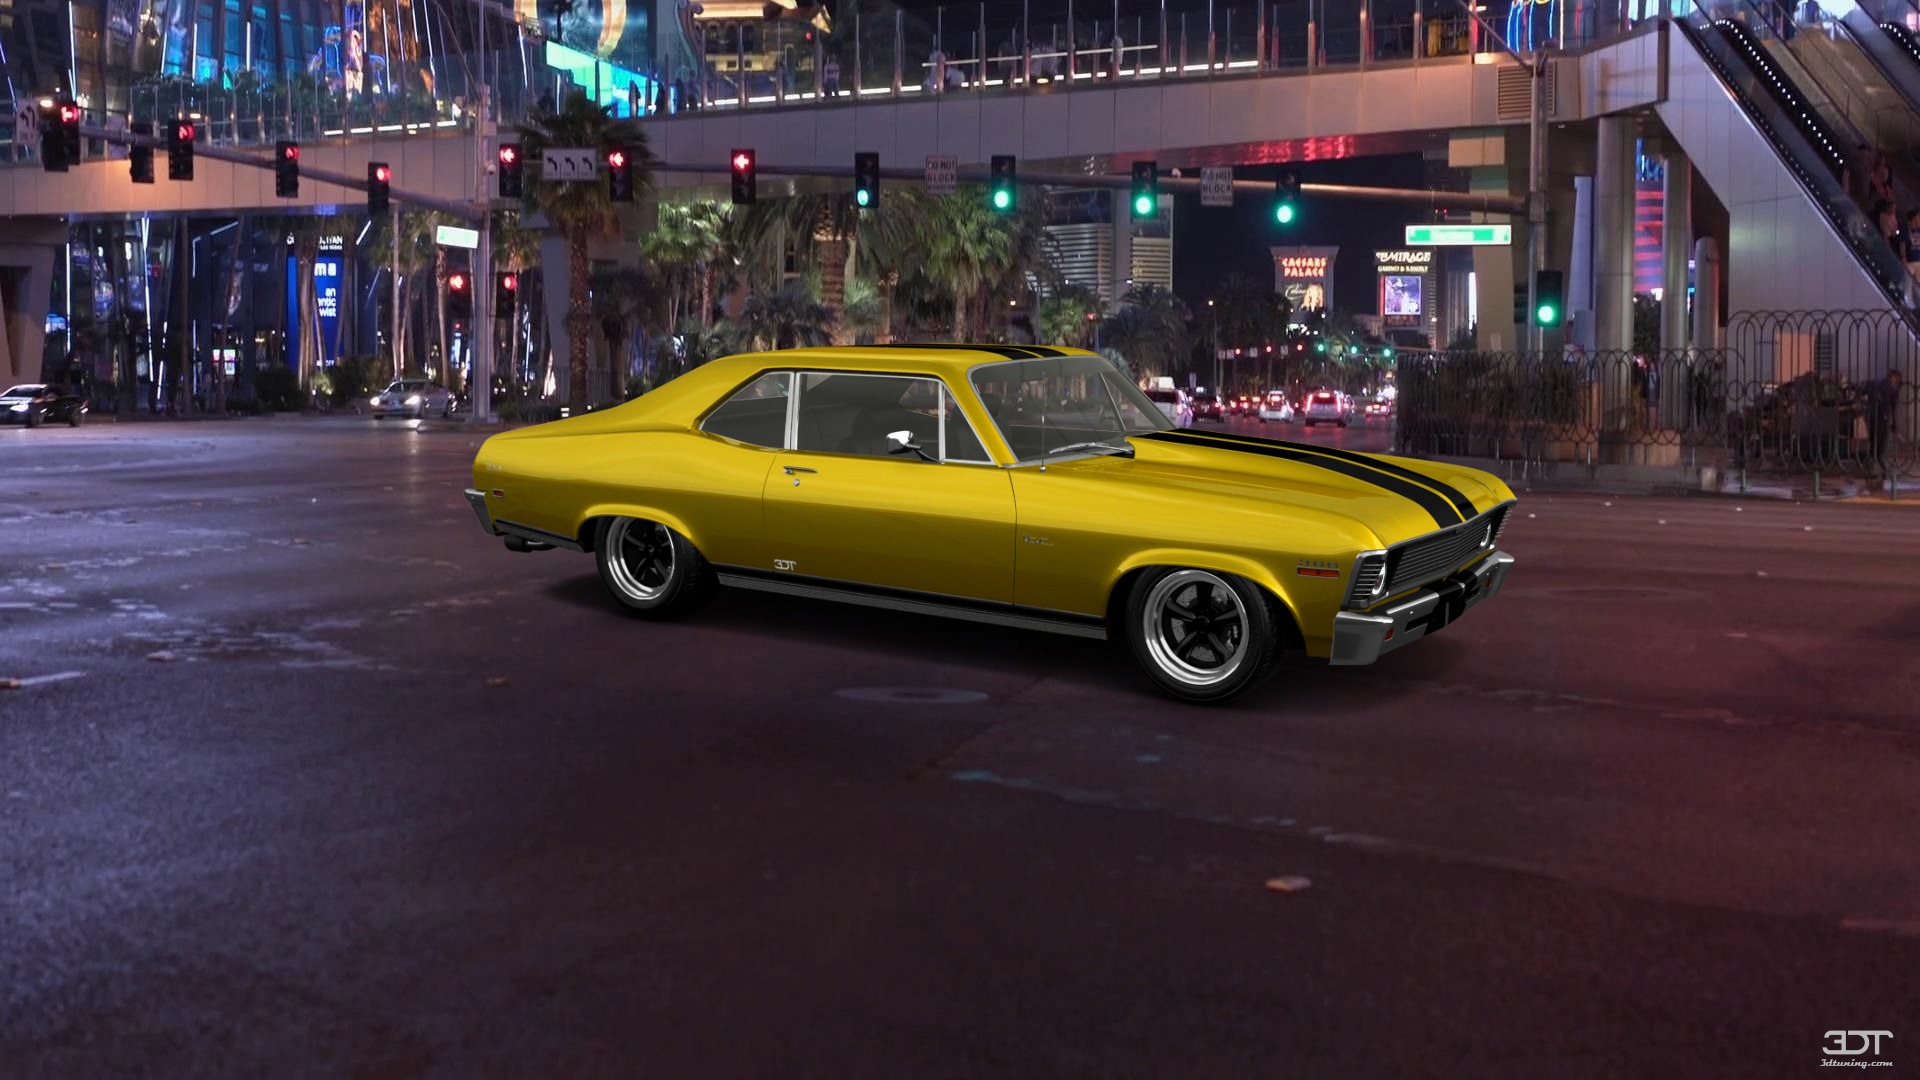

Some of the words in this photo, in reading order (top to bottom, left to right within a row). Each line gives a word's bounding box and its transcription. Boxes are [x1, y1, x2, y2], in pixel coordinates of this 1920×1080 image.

[1202, 183, 1231, 192] BLOCK
[1282, 257, 1327, 267] CAESARS
[1388, 251, 1431, 263] MIRAGE
[1284, 267, 1324, 278] PALACE
[774, 559, 797, 571] 3DT
